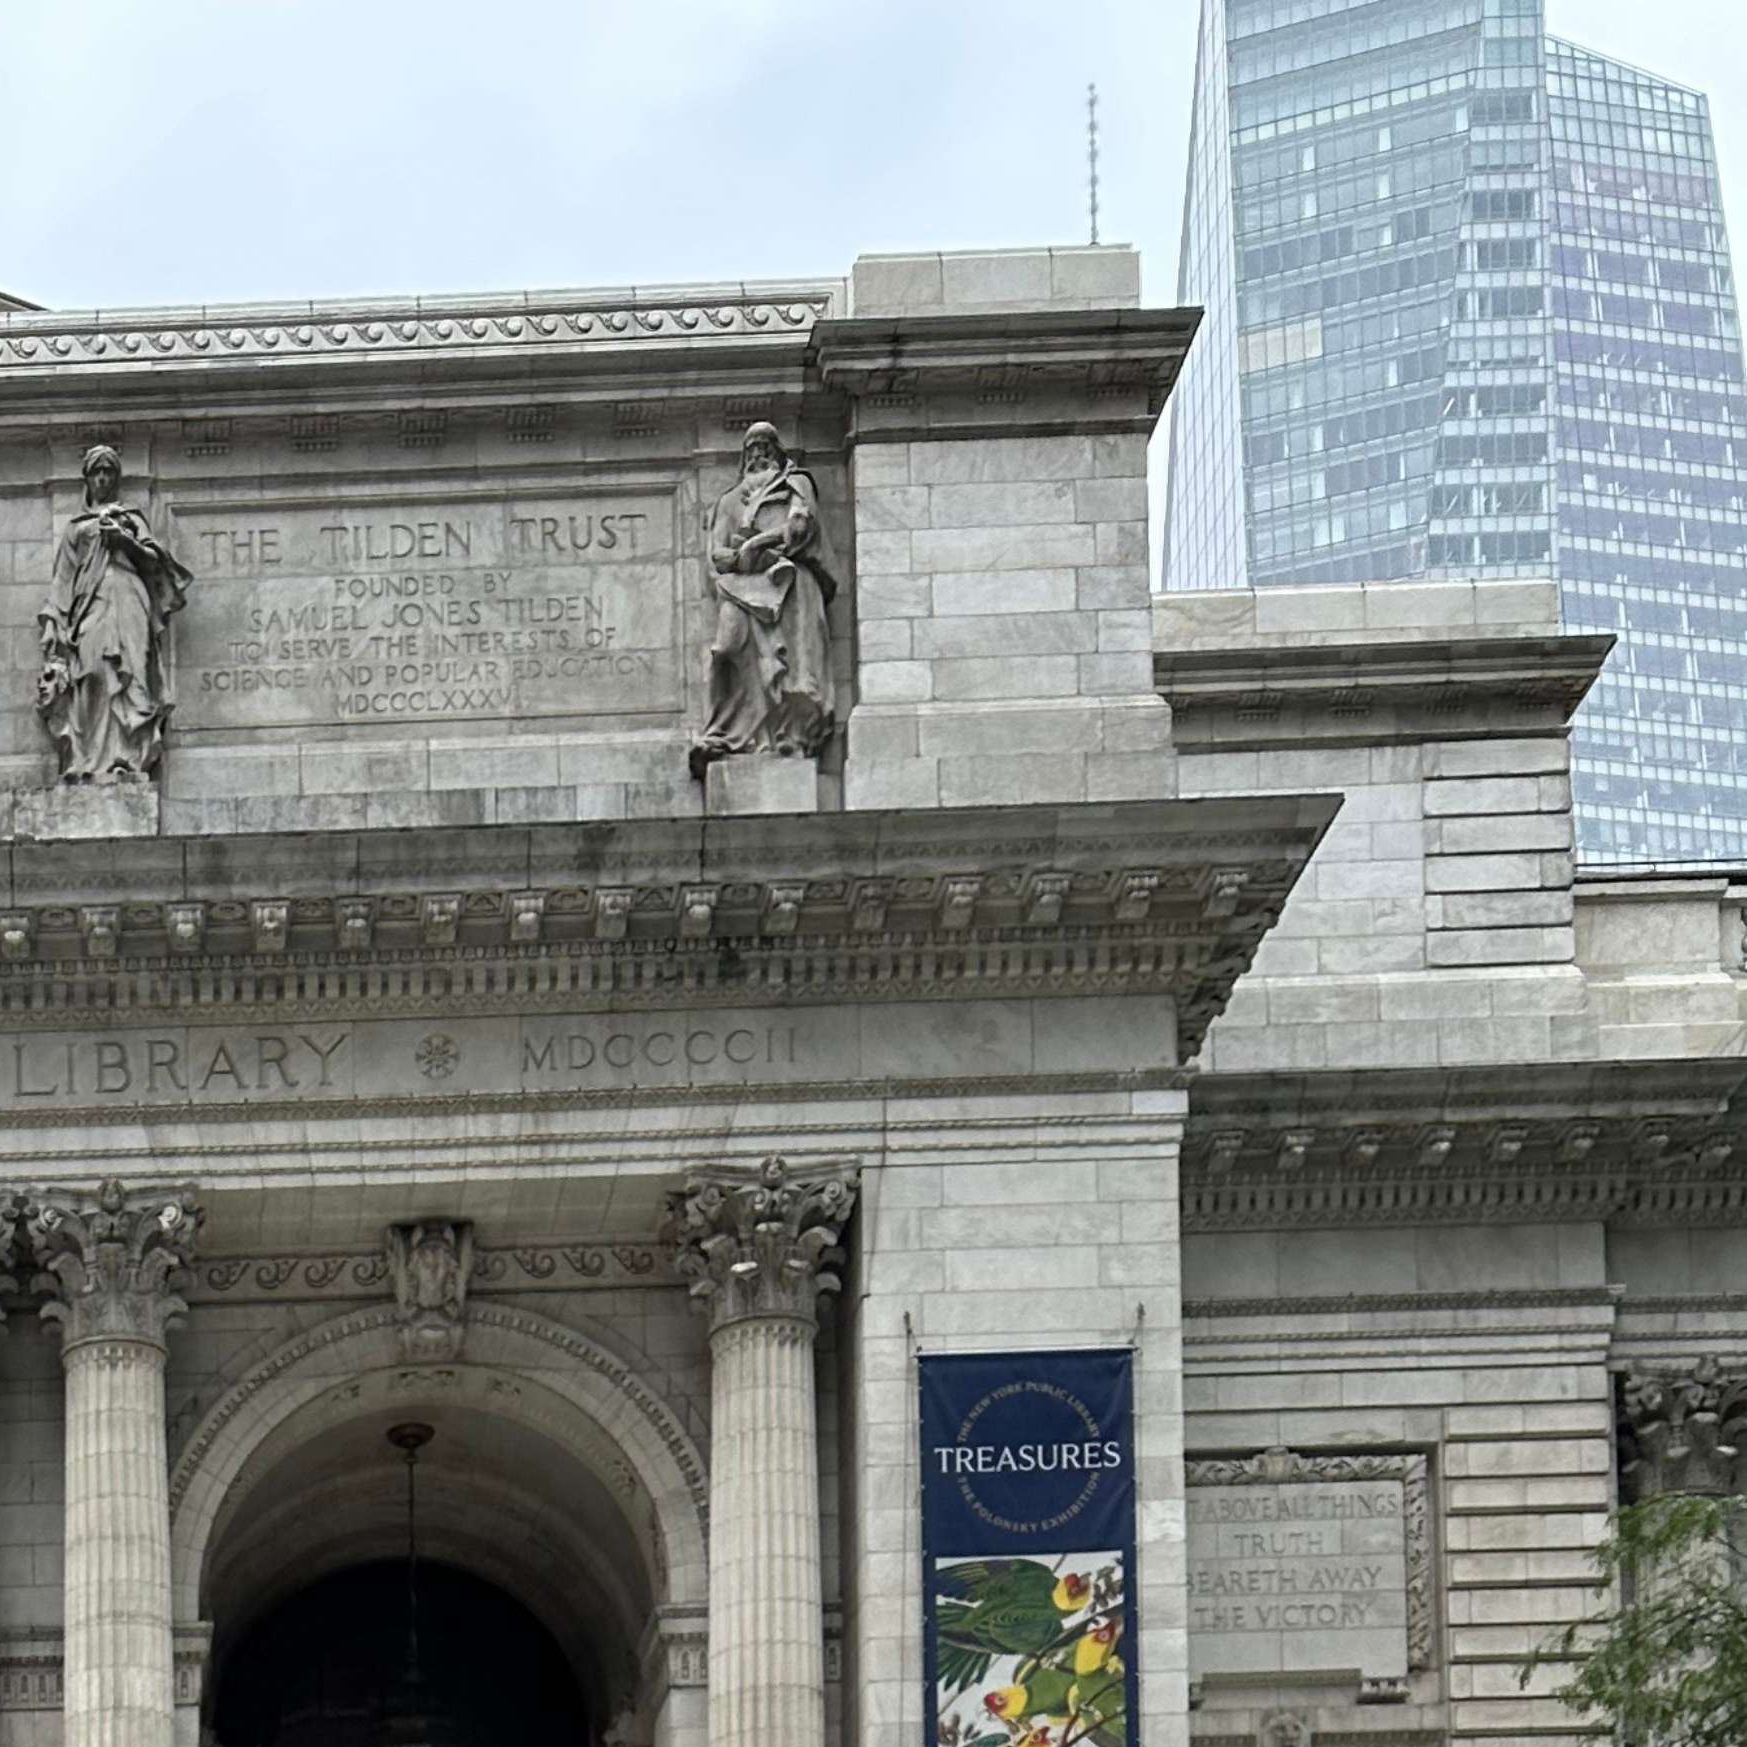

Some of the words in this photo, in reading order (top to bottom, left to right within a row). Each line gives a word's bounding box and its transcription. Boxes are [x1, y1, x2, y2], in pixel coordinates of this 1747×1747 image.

[201, 528, 283, 567] THE
[320, 520, 473, 563] TILDEN
[509, 513, 647, 554] TRUST
[334, 574, 453, 599] FOUNDED
[484, 571, 513, 593] BY
[252, 605, 369, 633] SAMUEL
[382, 600, 483, 628] JONES
[501, 595, 604, 624] TILDEN
[280, 638, 353, 660] SERVE
[369, 634, 418, 656] THE
[430, 629, 570, 654] INTERESTS
[585, 627, 616, 649] OF
[200, 668, 308, 693] SCIENCE
[321, 665, 373, 688] AND
[386, 661, 499, 685] POPULAR
[512, 654, 653, 681] EDUCATION
[13, 1033, 350, 1097] LIBRARY
[523, 1026, 797, 1073] MDCCCCII
[1026, 1380, 1068, 1400] PUBLIC
[934, 1441, 1121, 1474] TREASURES
[1204, 1497, 1273, 1520] ABOVE
[1278, 1498, 1315, 1520] ALL
[1317, 1494, 1397, 1519] THINGS
[1233, 1532, 1323, 1555] TRUTH
[1308, 1566, 1382, 1590] AWAY
[1194, 1607, 1245, 1629] THE
[1254, 1602, 1372, 1628] VICTORY
